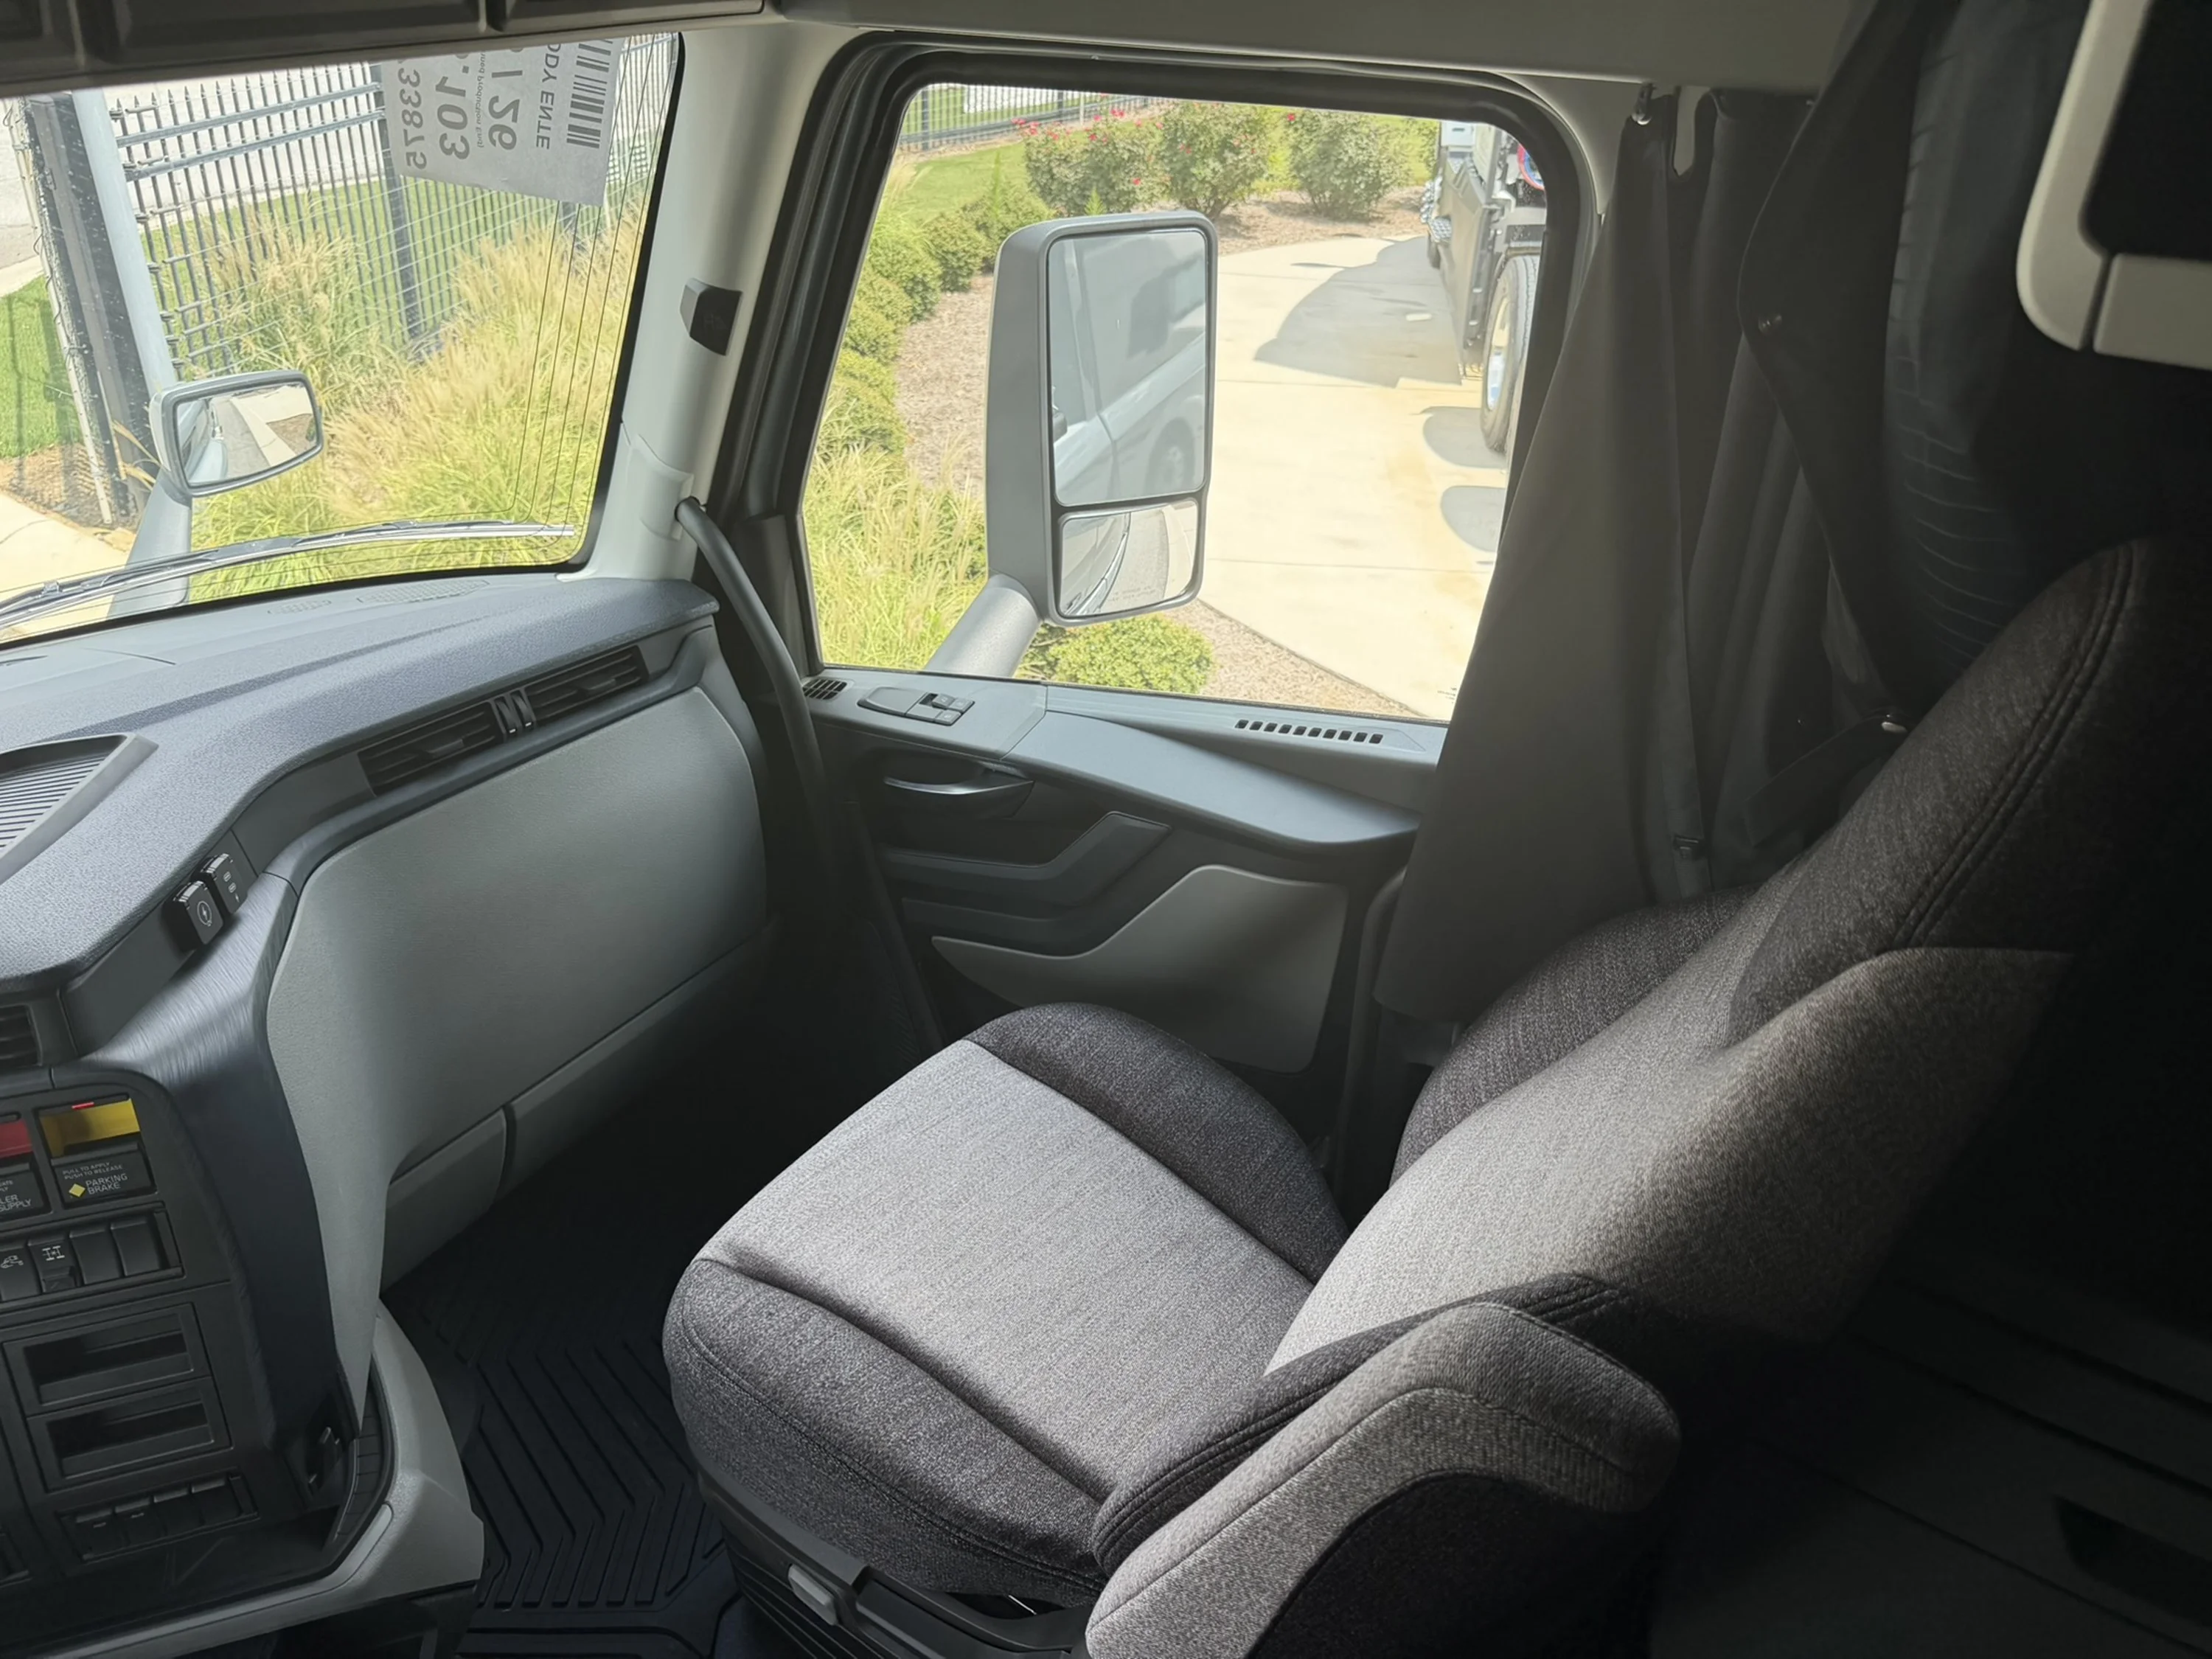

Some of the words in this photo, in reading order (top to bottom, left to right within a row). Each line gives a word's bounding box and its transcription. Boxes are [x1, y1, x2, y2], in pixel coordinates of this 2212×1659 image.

[94, 1165, 122, 1174] RELEASE
[86, 1173, 128, 1186] PARKING
[88, 1181, 121, 1194] BRAKE
